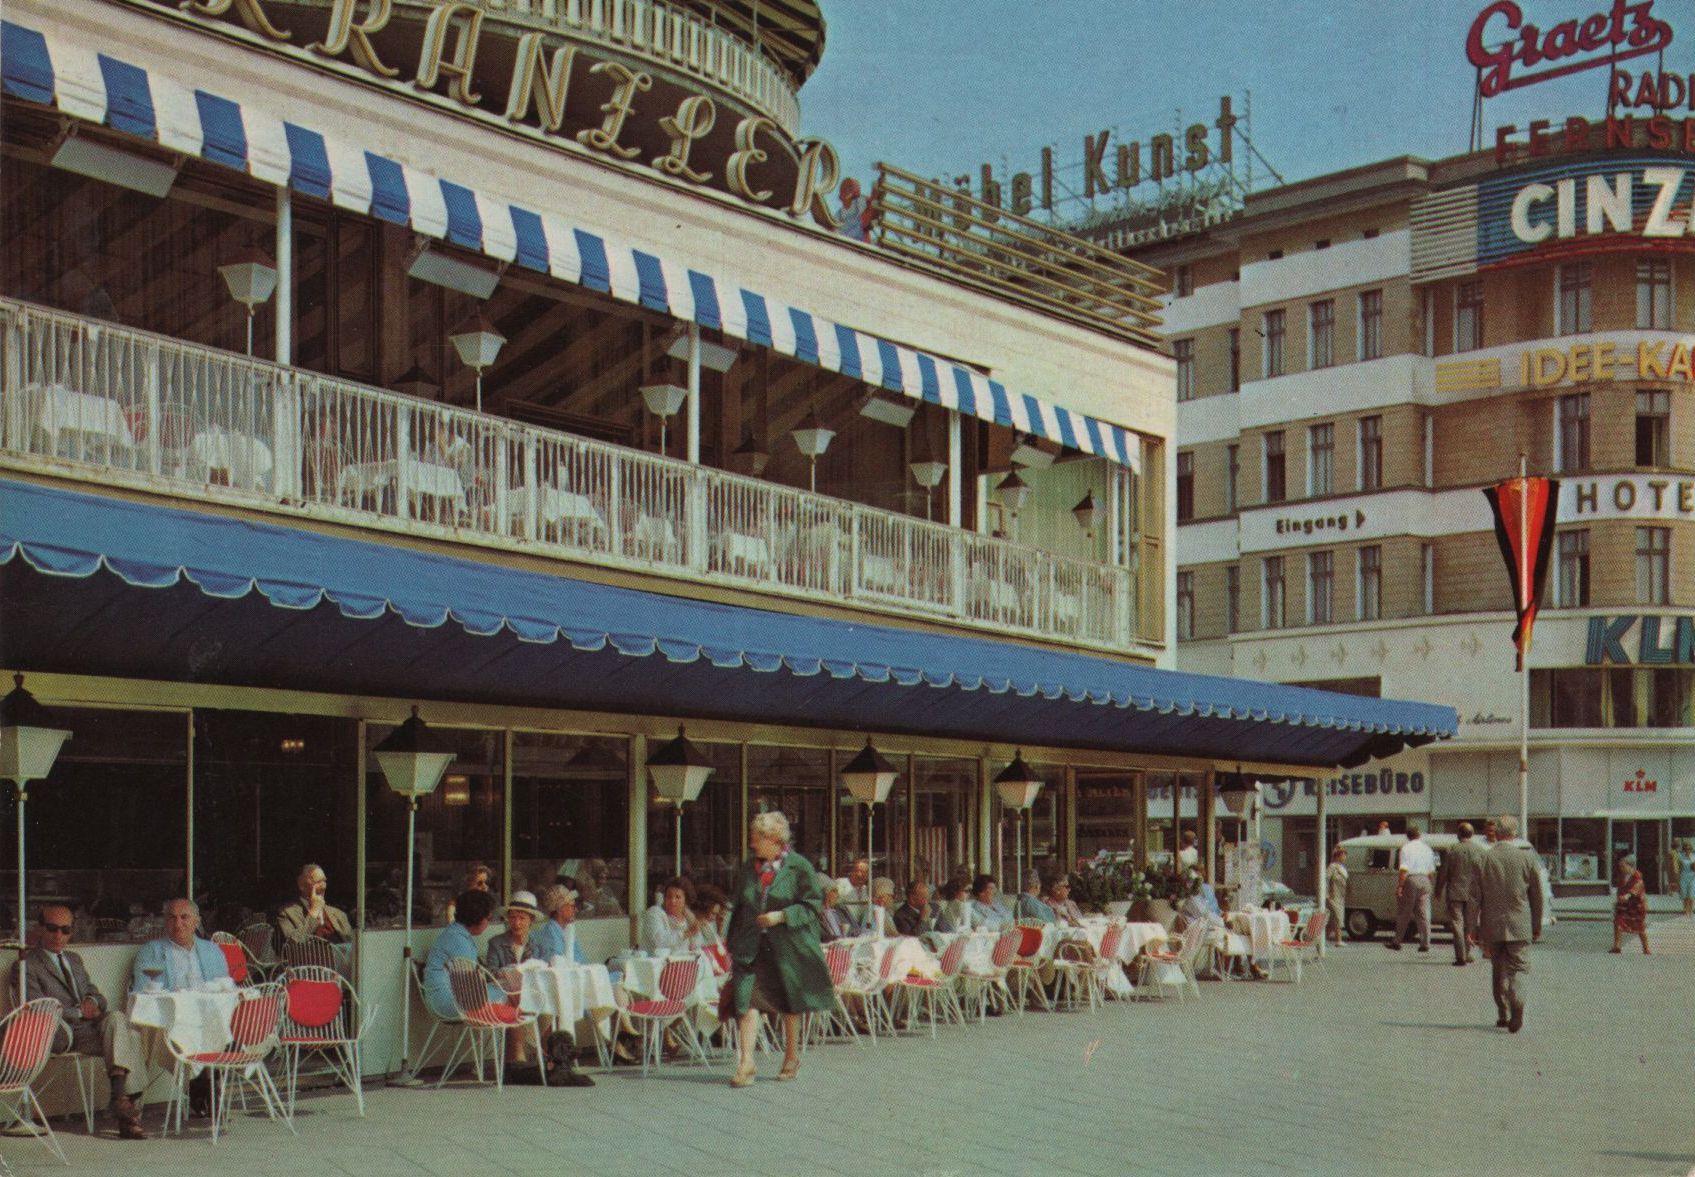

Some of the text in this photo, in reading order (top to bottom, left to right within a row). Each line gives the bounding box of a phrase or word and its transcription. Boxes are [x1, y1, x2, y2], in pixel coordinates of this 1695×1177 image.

[1466, 0, 1673, 97] Graetz
[1084, 96, 1237, 199] Kunst
[1511, 167, 1695, 243] CINZ
[1276, 514, 1349, 534] Eingang
[1304, 767, 1424, 796] RISEBÜRO
[1623, 780, 1657, 792] KLM
